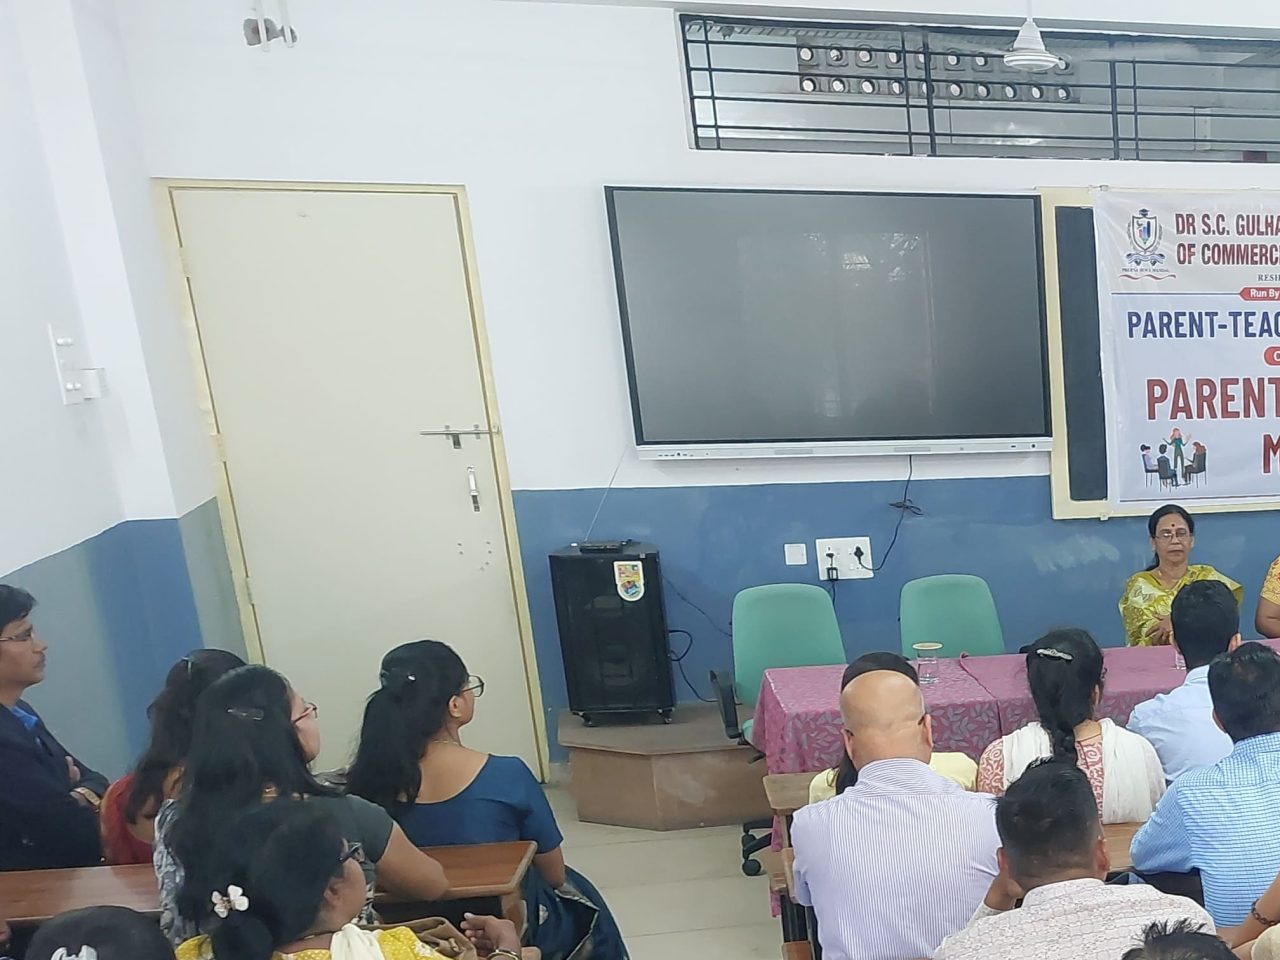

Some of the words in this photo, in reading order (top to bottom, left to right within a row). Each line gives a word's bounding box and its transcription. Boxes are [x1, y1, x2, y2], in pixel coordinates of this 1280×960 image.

[1175, 213, 1197, 235] DR
[1201, 213, 1230, 236] S.C.
[1176, 243, 1197, 265] OF
[1250, 288, 1268, 298] Run
[1268, 288, 1280, 300] By
